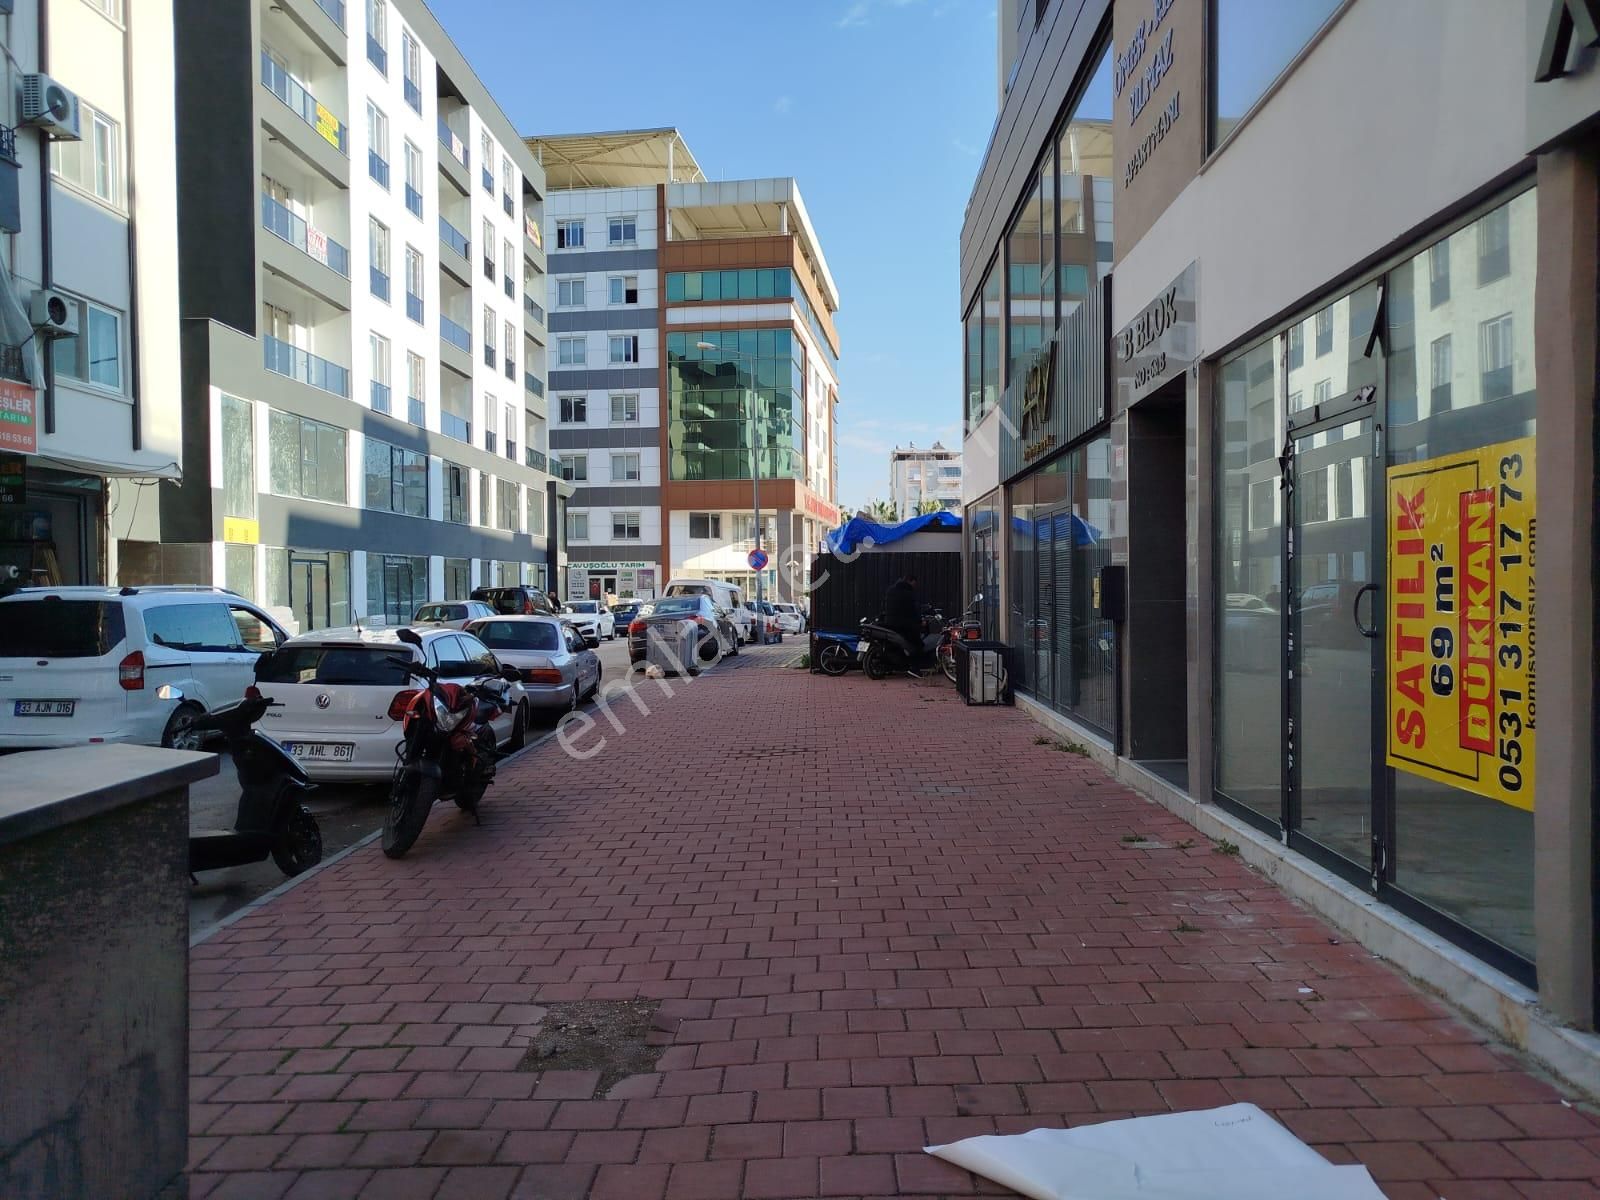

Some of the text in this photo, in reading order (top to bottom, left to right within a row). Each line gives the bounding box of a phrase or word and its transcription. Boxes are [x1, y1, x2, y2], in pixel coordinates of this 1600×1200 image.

[1129, 28, 1174, 126] YILMAZ
[1125, 90, 1181, 189] APARTMANI
[1124, 286, 1177, 363] B BLOK
[1396, 488, 1426, 749] SATILIK
[1431, 627, 1453, 696] 69
[1463, 503, 1490, 742] DÜKKAN
[1499, 453, 1522, 792] 0531 317 17 73
[20, 703, 71, 713] 33 AJN 016
[291, 745, 350, 757] 33 AHL 861
